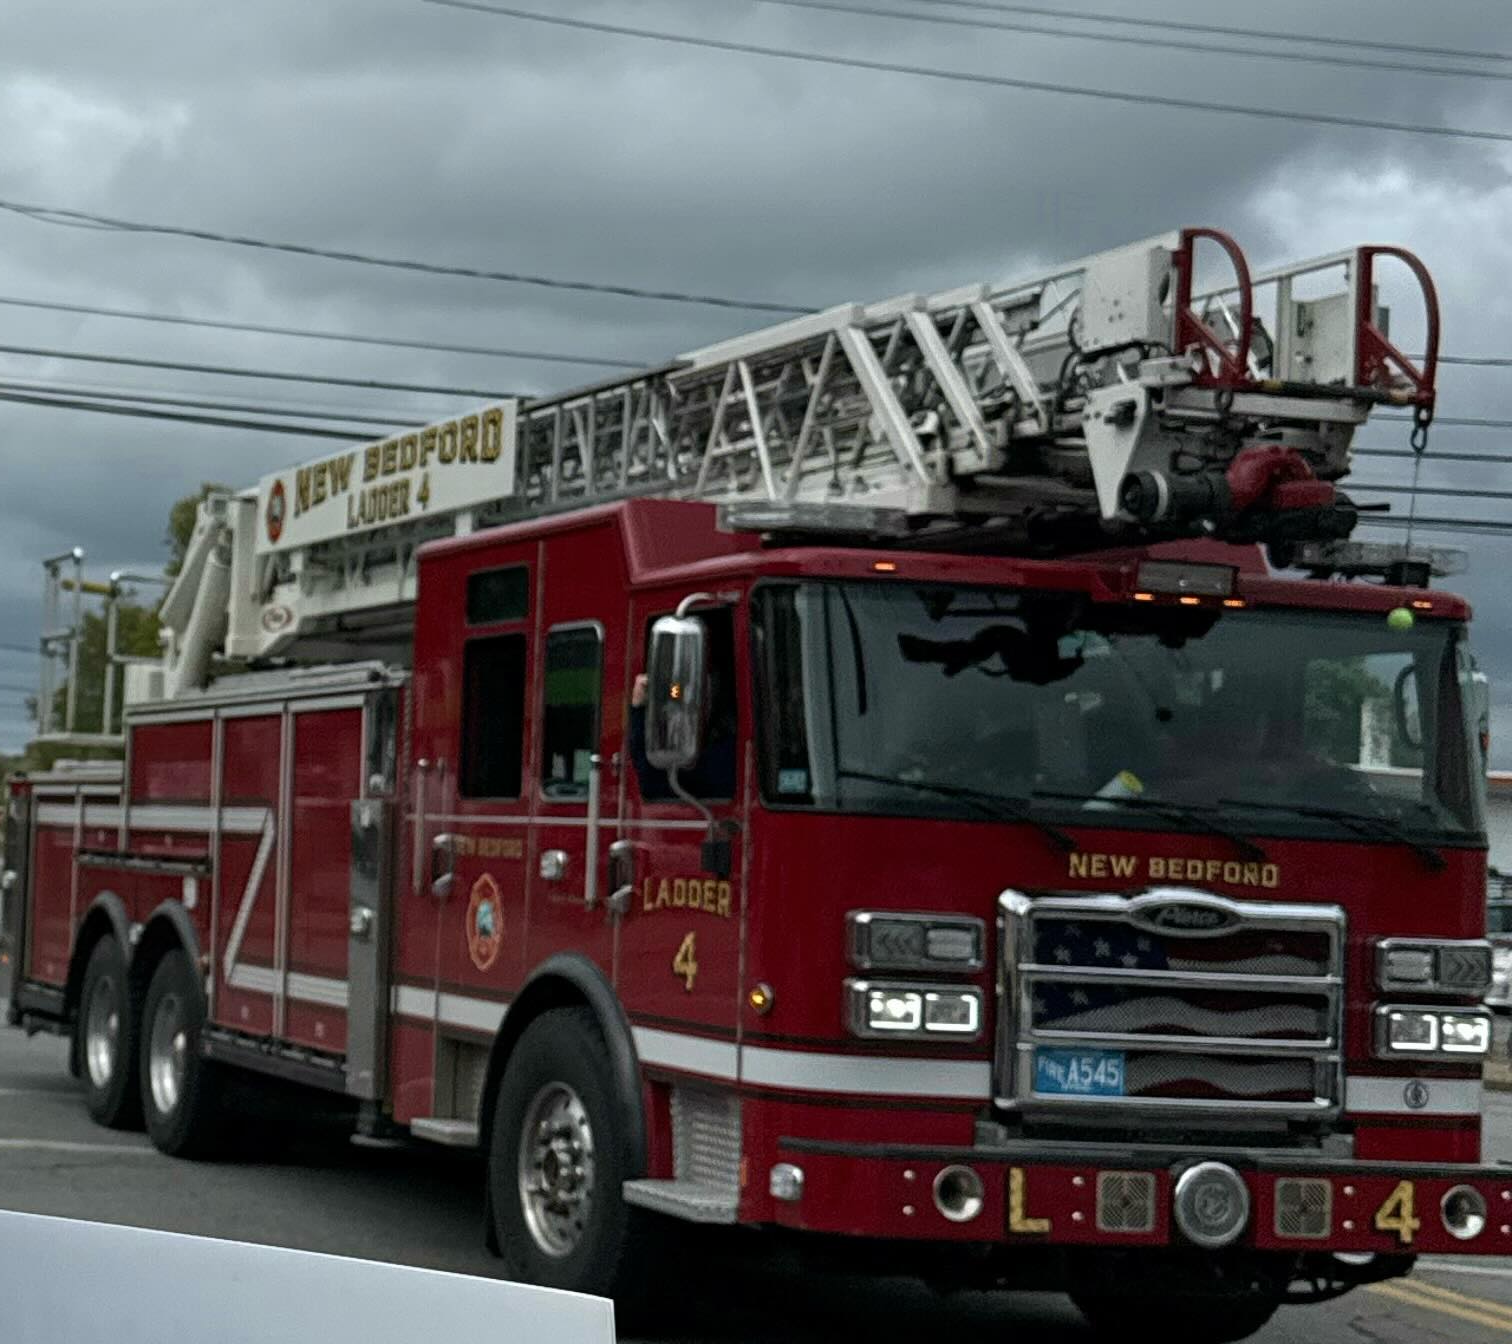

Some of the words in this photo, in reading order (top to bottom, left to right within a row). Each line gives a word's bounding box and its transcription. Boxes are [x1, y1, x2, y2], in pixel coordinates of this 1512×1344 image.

[294, 452, 356, 519] NEW
[363, 406, 505, 483] BEDFORD
[346, 477, 412, 530] LADDER
[416, 471, 430, 511] 4
[643, 877, 732, 919] LADDER
[1068, 852, 1137, 879] NEW
[1148, 856, 1281, 889] BEDFORD
[672, 930, 699, 993] 4
[1068, 1056, 1120, 1088] A545
[1008, 1166, 1052, 1233] L
[1374, 1179, 1422, 1244] 4
